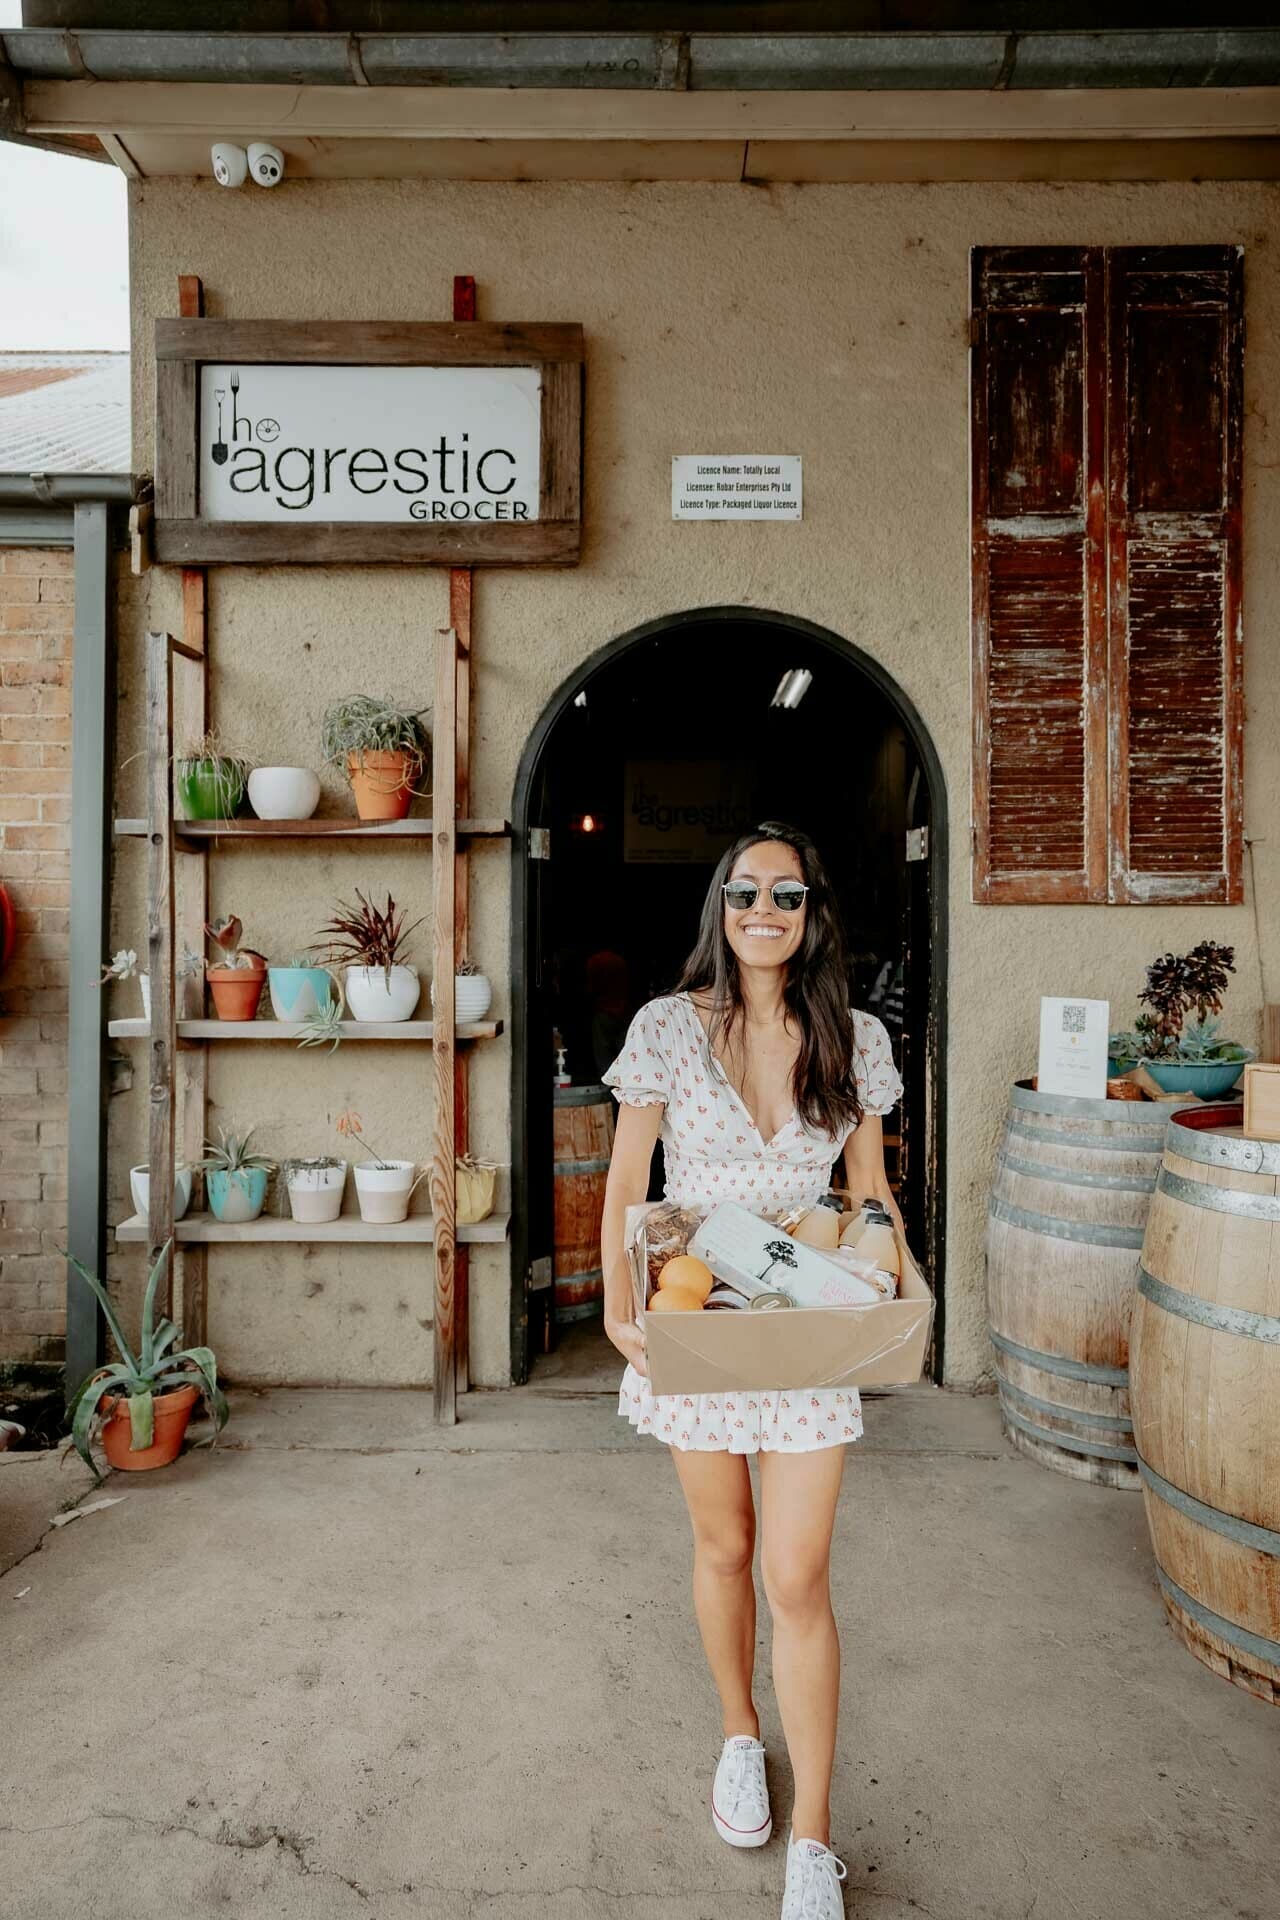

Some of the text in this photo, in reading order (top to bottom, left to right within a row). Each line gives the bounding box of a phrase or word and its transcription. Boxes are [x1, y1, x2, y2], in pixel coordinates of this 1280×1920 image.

[229, 433, 517, 510] agrestic
[697, 465, 781, 476] Licence Name: Totally Local
[686, 482, 715, 492] Licensee:
[735, 482, 770, 493] Enterprises
[771, 482, 781, 493] Pty
[782, 482, 791, 492] Ltd
[680, 499, 798, 510] Licence Type: Packaged Liquor Licence
[409, 500, 529, 521] GROCER
